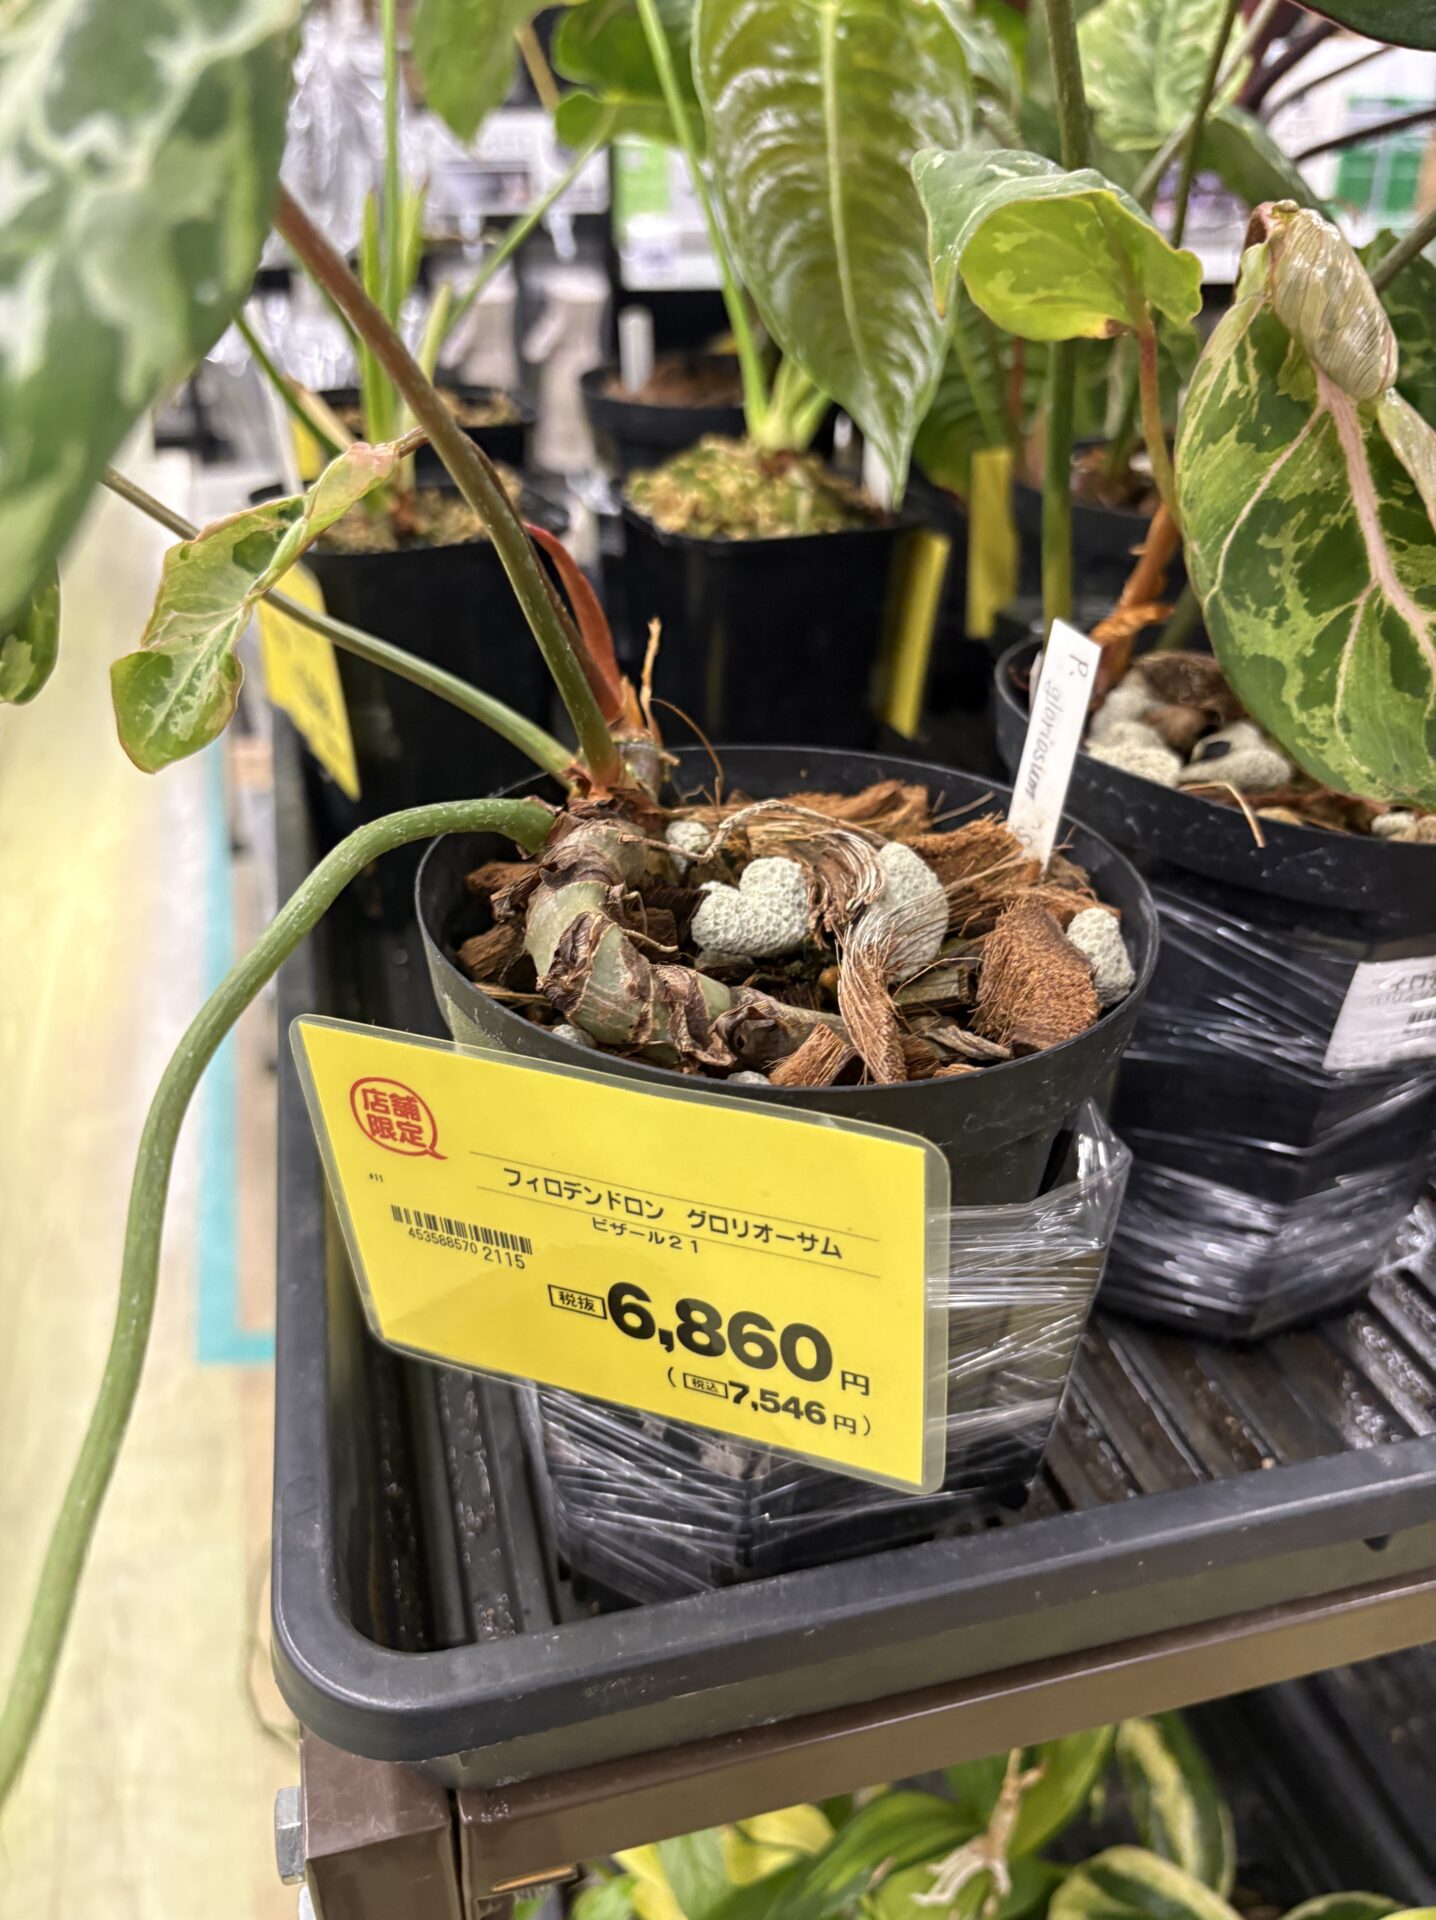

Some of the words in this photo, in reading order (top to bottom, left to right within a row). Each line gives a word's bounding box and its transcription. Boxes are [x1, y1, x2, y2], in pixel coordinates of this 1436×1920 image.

[1025, 679, 1064, 799] gloriosum
[361, 1087, 422, 1122] 店舗
[366, 1113, 427, 1149] 限定
[503, 1167, 664, 1220] フィロデンドロン
[687, 1208, 843, 1260] グロリオーサム
[607, 1281, 833, 1383] 6,860
